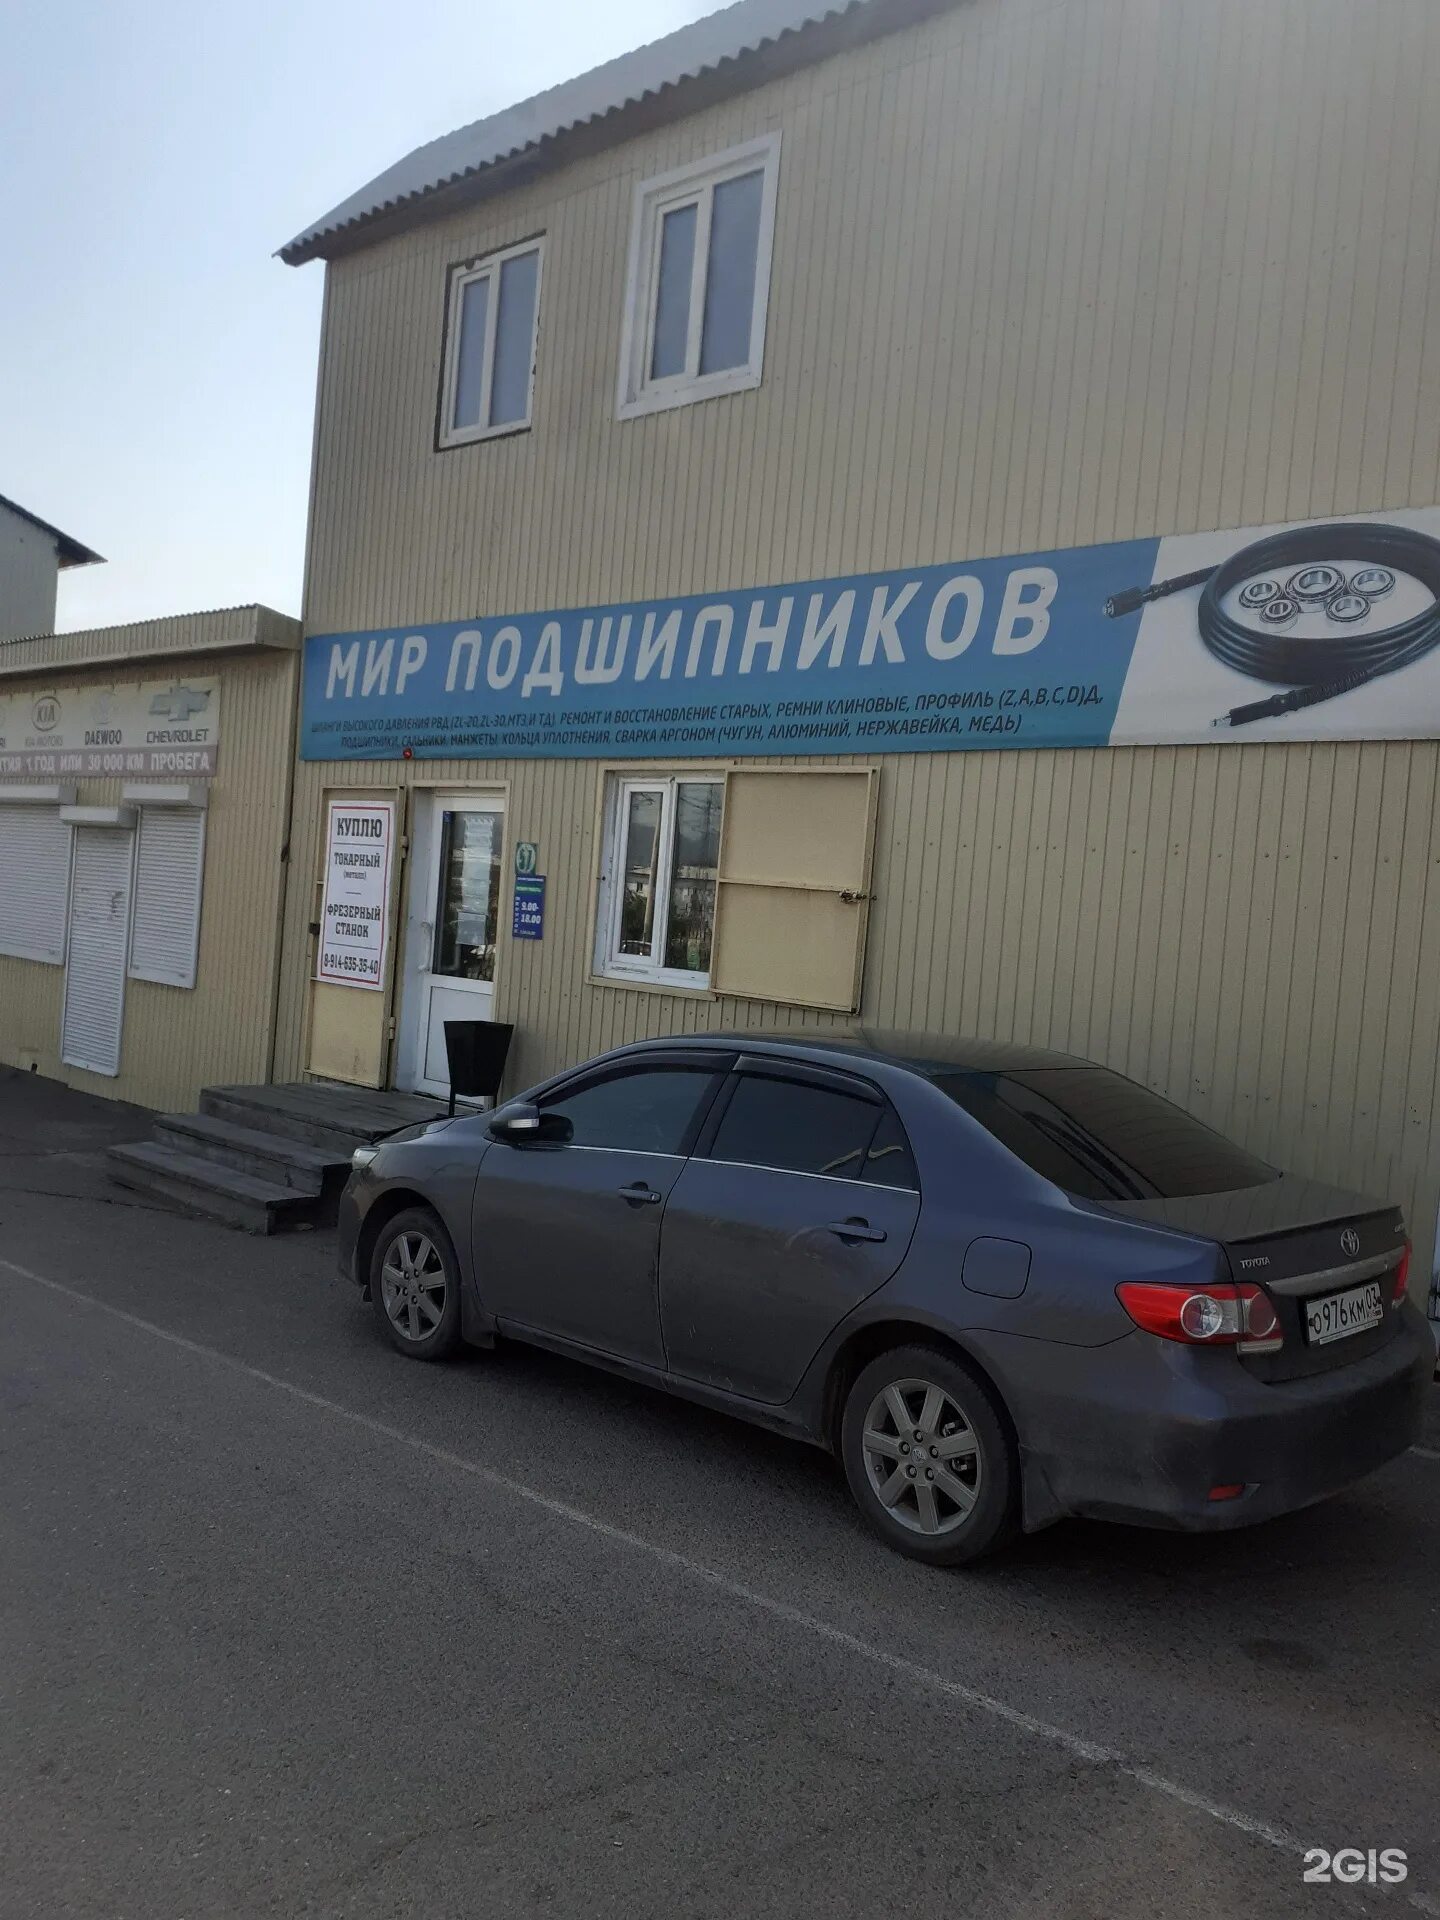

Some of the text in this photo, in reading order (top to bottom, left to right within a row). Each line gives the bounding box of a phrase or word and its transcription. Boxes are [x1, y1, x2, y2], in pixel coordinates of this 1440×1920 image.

[326, 566, 1059, 698] МИР ПОДШИПНИКОВ
[383, 717, 430, 732] ДАВЛЕНИЯ
[559, 710, 602, 726] РЕМОНТ
[603, 711, 613, 724] И
[613, 705, 718, 724] ВОССТАНОВЛЕНИЕ
[720, 702, 772, 720] СТАРЫХ,
[776, 699, 823, 717] РЕМНИ
[825, 695, 911, 715] КЛИНОВЫЕ,
[914, 690, 994, 711] ПРОФИЛЬ
[84, 729, 122, 745] DAEWOO
[146, 728, 209, 744] CHEVROLET
[501, 731, 541, 747] КОЛЬЦА
[541, 729, 611, 745] УПЛОТНЕНИЯ,
[614, 729, 658, 744] СВАРКА
[660, 727, 716, 743] АРГОНОМ
[717, 724, 764, 744] (ЧУГУН,
[767, 717, 852, 741] АЛЮМИНИЙ,
[855, 714, 962, 737] НЕРЖАВЕЙКА,
[967, 713, 1022, 735] МЕДЬ)
[126, 753, 144, 770] КМ
[150, 751, 210, 770] ПРОБЕГА
[337, 817, 383, 838] КУПЛЮ
[334, 852, 381, 868] ТОКАРНЫЙ
[327, 903, 381, 921] ФРЕЗЕРНЫЙ
[335, 922, 369, 938] СТАНОК
[323, 953, 379, 975] 8-914-635-35-40
[1240, 1256, 1271, 1269] TOYOTA
